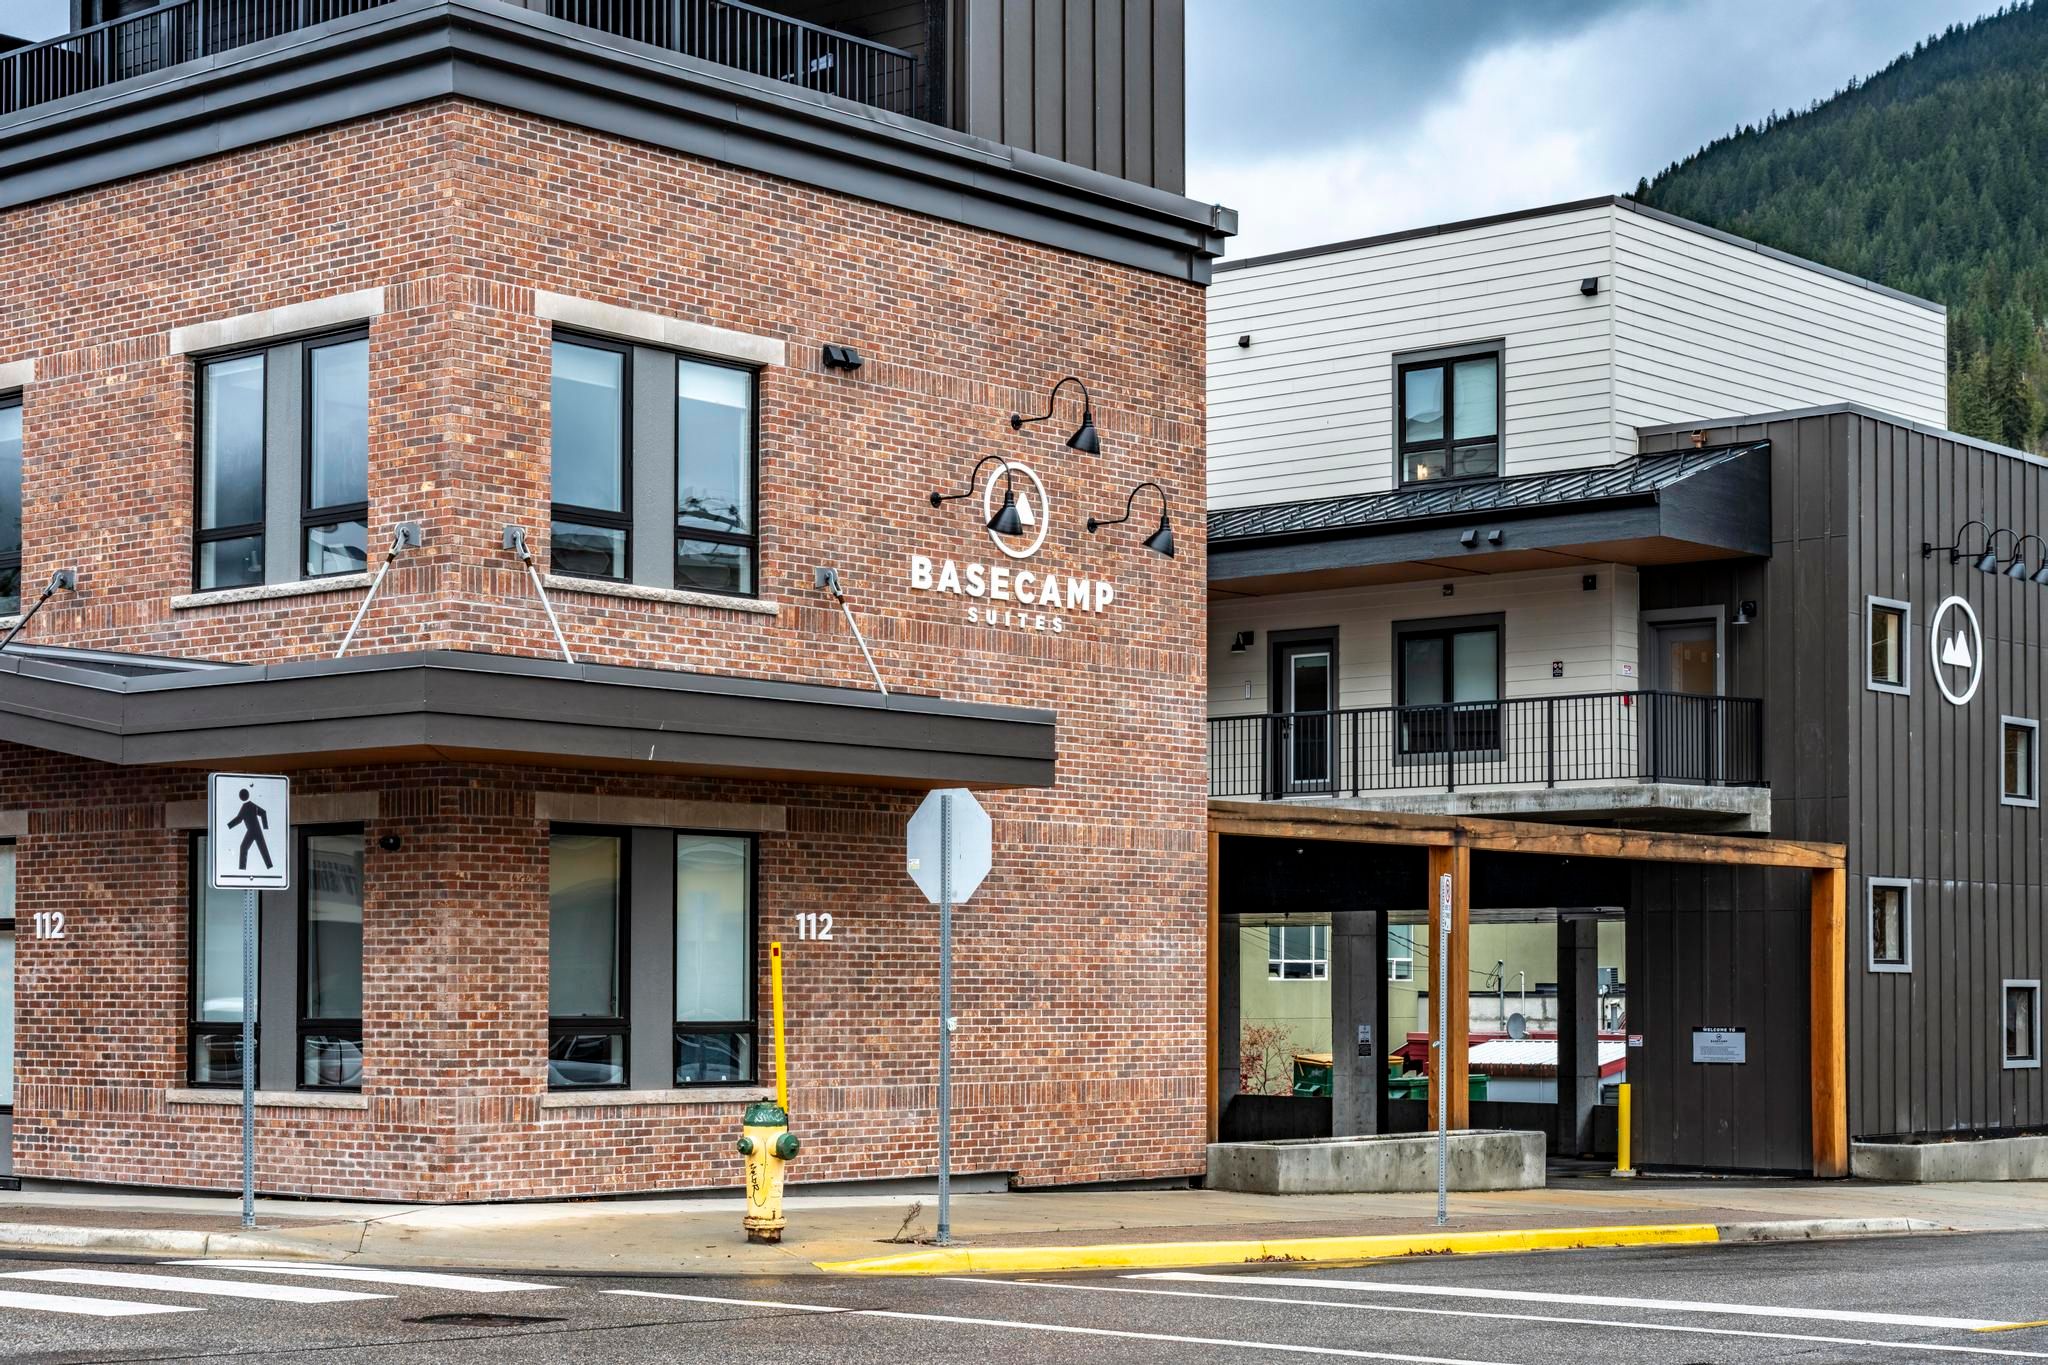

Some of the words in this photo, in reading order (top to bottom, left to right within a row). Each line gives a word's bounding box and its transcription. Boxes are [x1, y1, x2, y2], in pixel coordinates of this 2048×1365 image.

[911, 555, 1114, 613] BASECAMP
[967, 607, 1063, 633] SUITES
[33, 911, 65, 939] 112
[795, 912, 833, 940] 112
